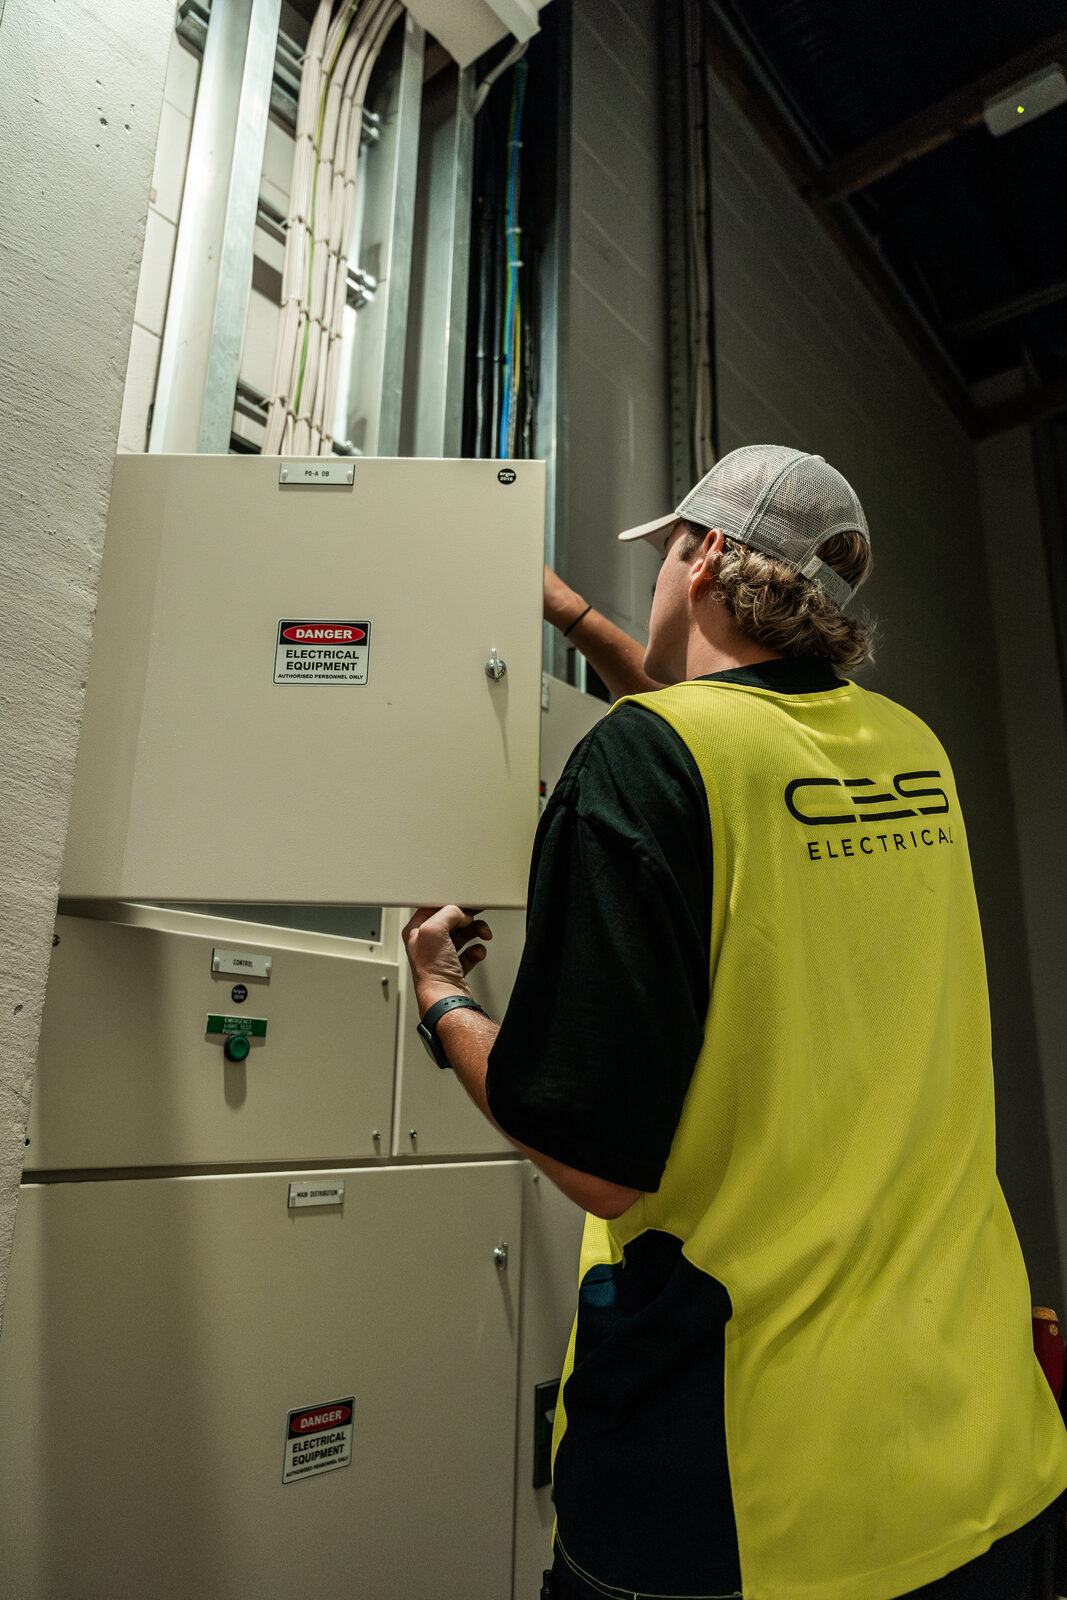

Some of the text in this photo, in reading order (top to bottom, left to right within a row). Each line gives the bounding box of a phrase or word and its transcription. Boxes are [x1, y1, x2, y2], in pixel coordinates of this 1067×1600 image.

[295, 629, 352, 640] DANGER
[285, 649, 359, 660] ELECTRICAL
[285, 661, 357, 672] EQUIPMENT
[233, 958, 254, 968] CONTROL
[300, 1410, 343, 1429] DANGER
[292, 1431, 347, 1454] ELECTRICAL
[292, 1443, 345, 1467] EQUIPMENT
